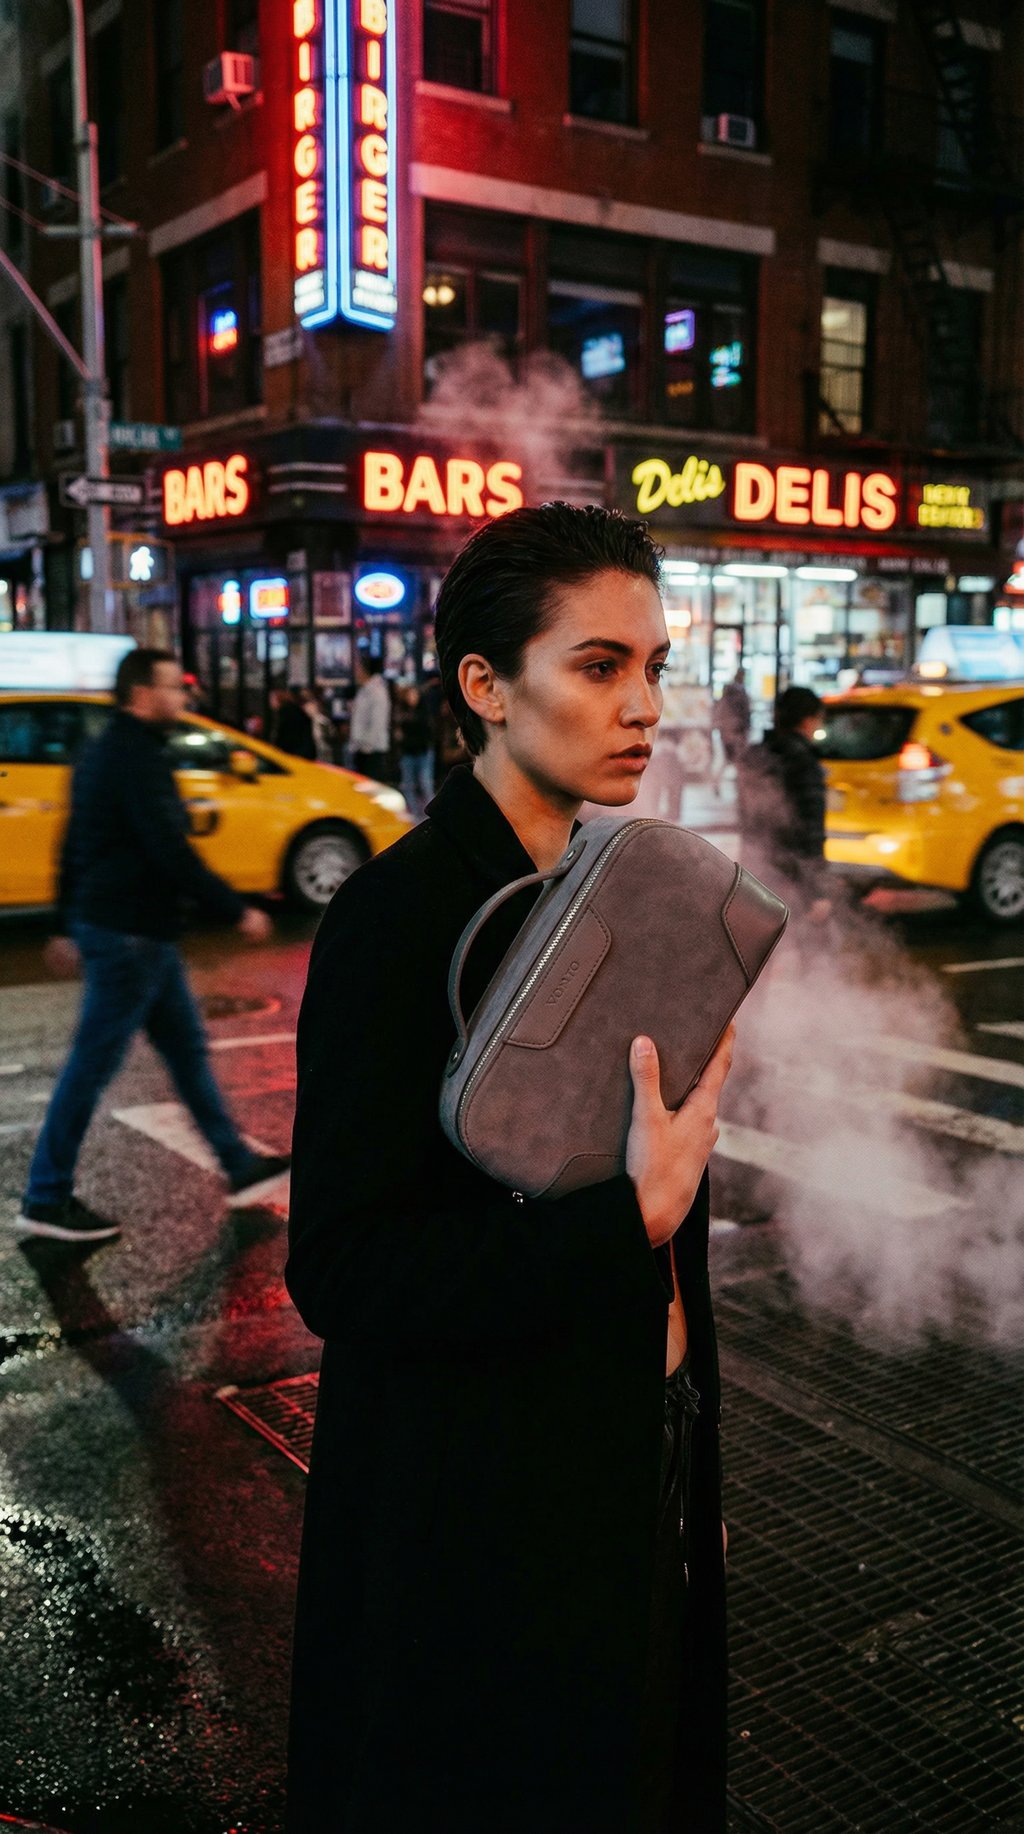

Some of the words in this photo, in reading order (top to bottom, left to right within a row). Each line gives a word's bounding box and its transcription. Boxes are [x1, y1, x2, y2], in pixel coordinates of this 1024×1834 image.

[294, 0, 318, 271] BIRGER
[361, 0, 388, 270] BIRGER
[164, 454, 248, 525] BARS
[364, 452, 523, 517] BARS
[632, 455, 725, 514] Delis
[734, 462, 897, 530] DELIS
[545, 960, 580, 1005] VONTO
